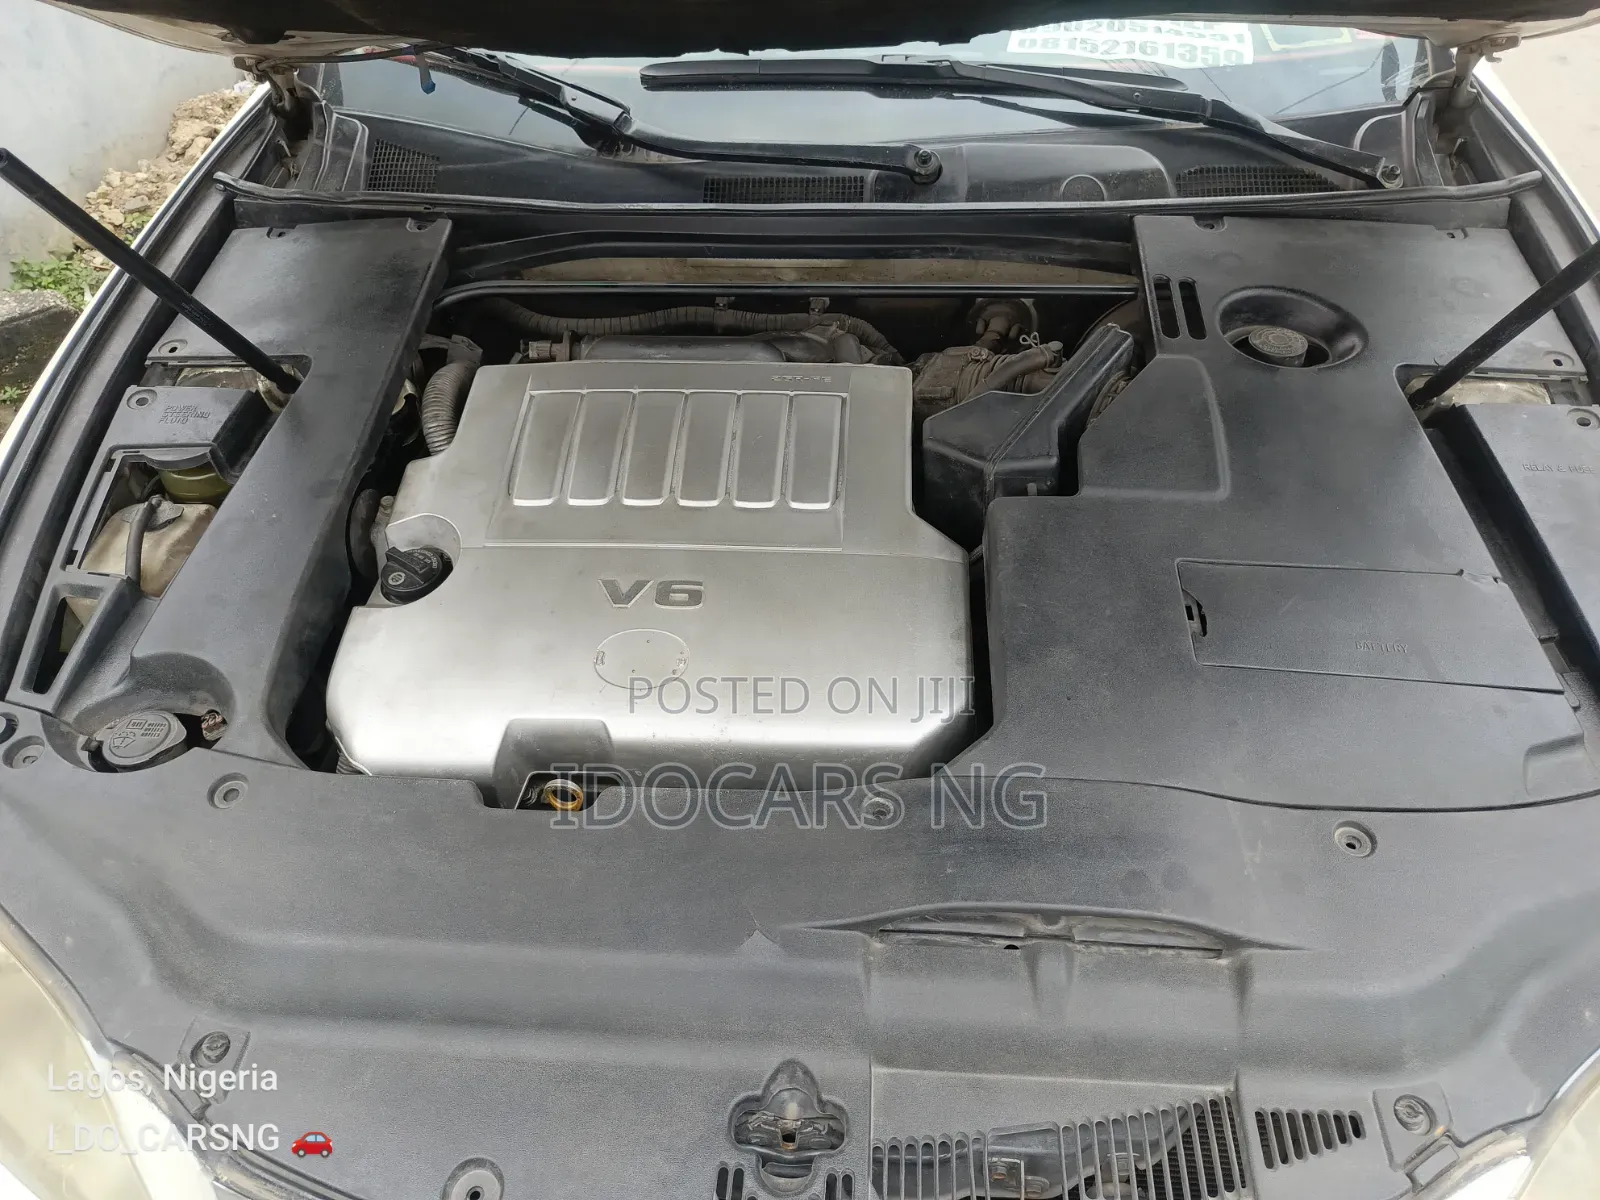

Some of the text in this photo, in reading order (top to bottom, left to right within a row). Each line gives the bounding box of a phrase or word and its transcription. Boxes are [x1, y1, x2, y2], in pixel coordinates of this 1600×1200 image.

[1522, 463, 1554, 472] RELAY
[598, 579, 705, 610] V6
[1354, 641, 1408, 653] BATTERY
